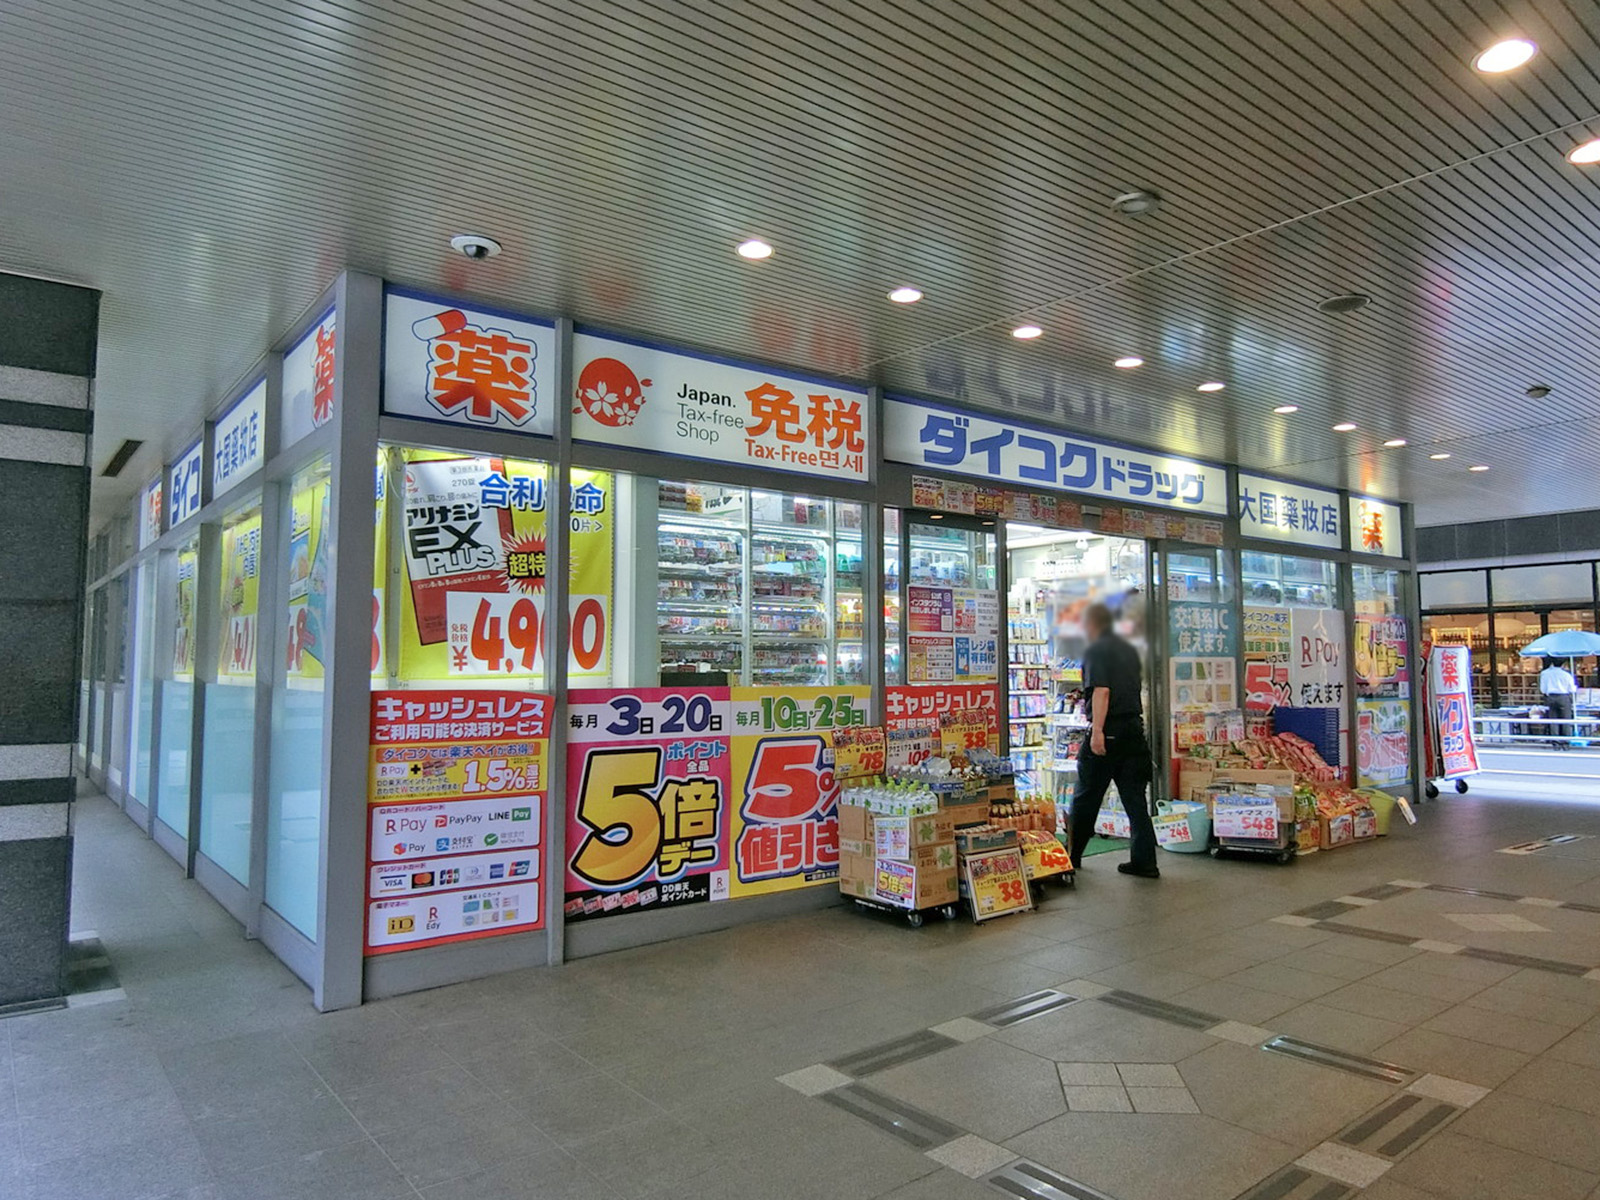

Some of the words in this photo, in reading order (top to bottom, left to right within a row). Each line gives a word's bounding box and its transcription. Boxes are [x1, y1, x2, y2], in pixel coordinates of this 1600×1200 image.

[415, 320, 535, 424] 薬
[677, 384, 736, 408] Japan.
[677, 402, 744, 429] Tax-free
[745, 382, 864, 452] 免税
[676, 420, 719, 444] Shop
[745, 438, 817, 466] Tax-Free
[819, 450, 863, 473] 면세
[920, 414, 1205, 504] ダイコクドラッグ
[478, 473, 606, 516] 合利命
[406, 503, 480, 527] アリナミン
[407, 522, 483, 559] EX
[425, 545, 498, 576] PLUS
[1174, 606, 1229, 630] 交通系IC
[471, 597, 605, 674] 4,90
[1178, 631, 1229, 653] 使えます。
[1315, 637, 1341, 667] Pay
[1441, 650, 1459, 688] 薬
[886, 690, 997, 716] キャッシュレス
[1301, 682, 1344, 705] 使えます
[376, 697, 545, 721] キャッシュレス
[736, 711, 760, 727] 毎月
[375, 721, 544, 741] ご利用可能な決済サービス
[570, 714, 598, 729] 毎月
[667, 741, 727, 760] ポイント
[963, 731, 986, 749] 38
[687, 760, 709, 773] 全品
[858, 751, 884, 771] 78
[463, 759, 525, 793] 1.5%
[400, 818, 427, 832] Pay
[449, 813, 482, 825] PayPay
[488, 812, 510, 821] LINE
[514, 809, 530, 818] Pay
[1241, 816, 1275, 831] 548
[408, 843, 426, 852] Pay
[383, 879, 404, 888] VISA
[999, 880, 1025, 903] 38
[426, 920, 442, 931] Edy
